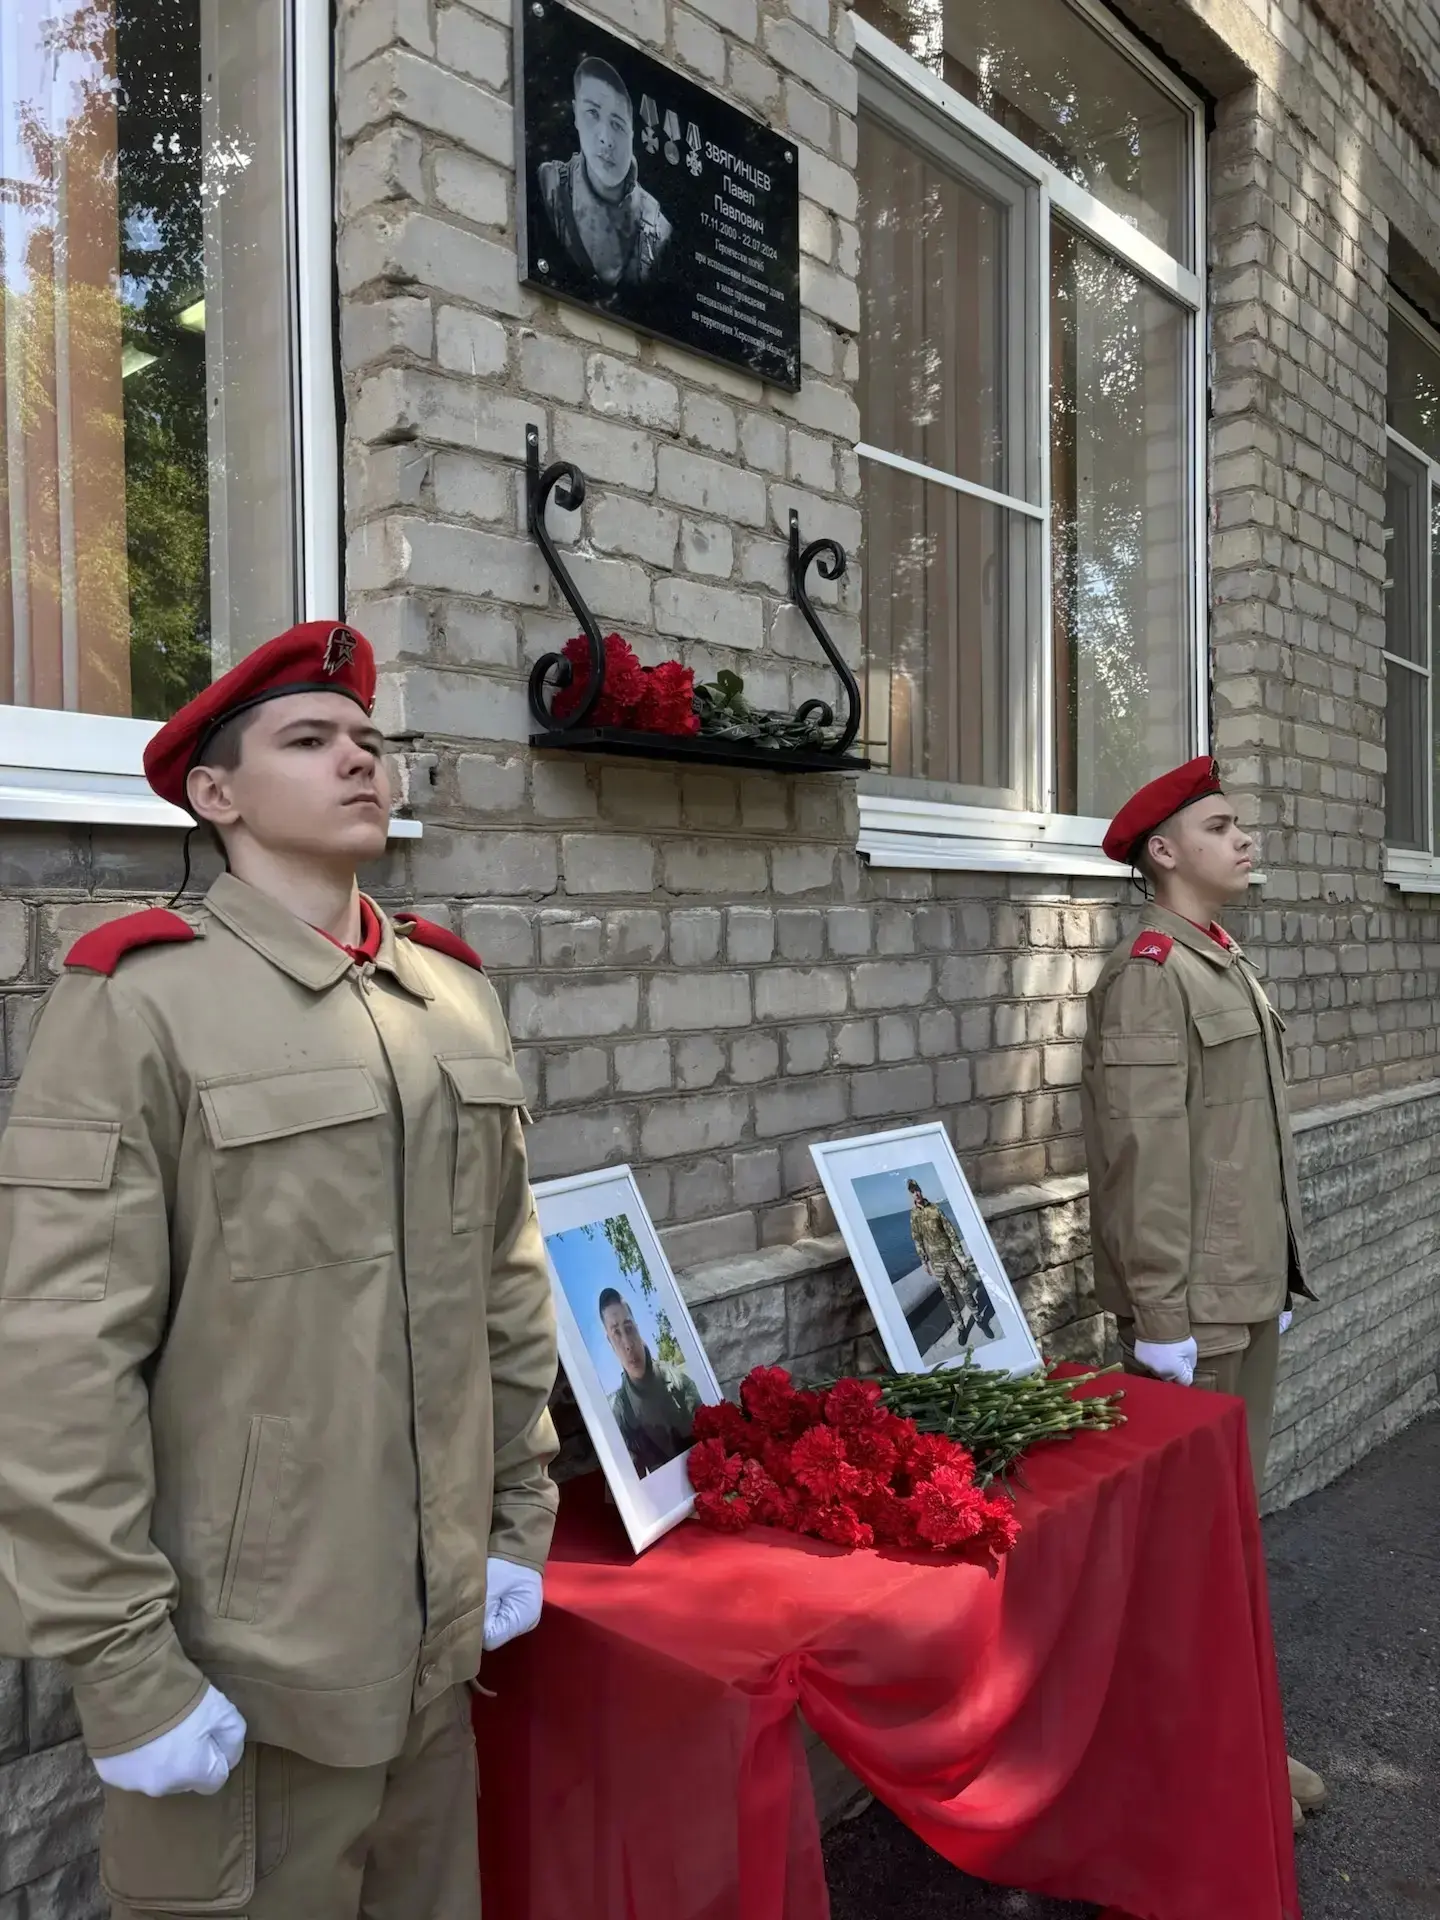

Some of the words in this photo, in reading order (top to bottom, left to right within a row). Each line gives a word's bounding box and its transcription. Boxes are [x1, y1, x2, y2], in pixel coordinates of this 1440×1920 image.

[705, 141, 771, 192] ЗВЯГИНЦЕВ
[723, 175, 755, 207] Павел
[714, 194, 764, 235] Павлович
[700, 212, 737, 240] 17.11.2000
[742, 234, 778, 260] 22.07.2024
[715, 239, 748, 264] Героически
